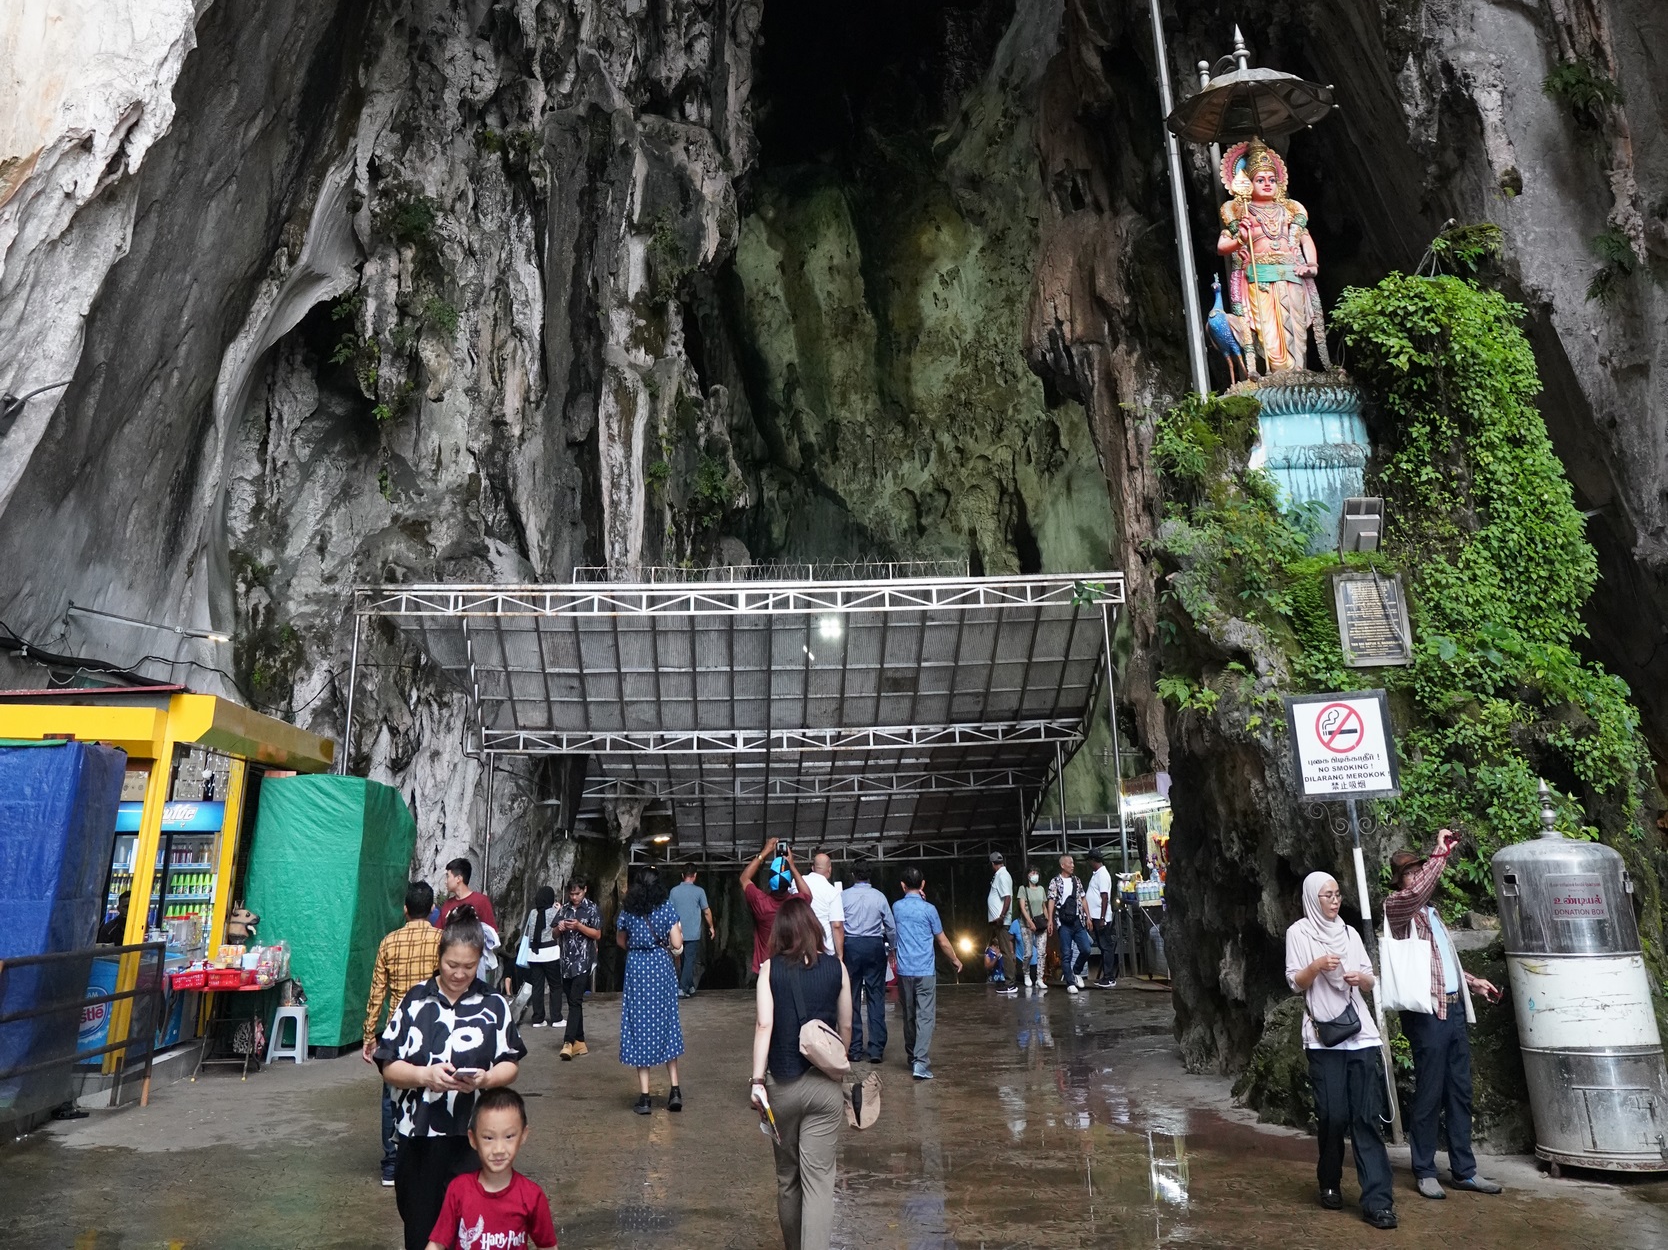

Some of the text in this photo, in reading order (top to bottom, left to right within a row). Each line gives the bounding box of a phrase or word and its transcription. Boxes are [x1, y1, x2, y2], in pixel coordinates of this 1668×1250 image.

[1332, 763, 1369, 772] SMOKING
[1304, 774, 1344, 783] DILARANG
[1346, 771, 1386, 780] MEROKOK
[1331, 780, 1367, 790] 禁止吸烟
[480, 1232, 507, 1250] Harry
